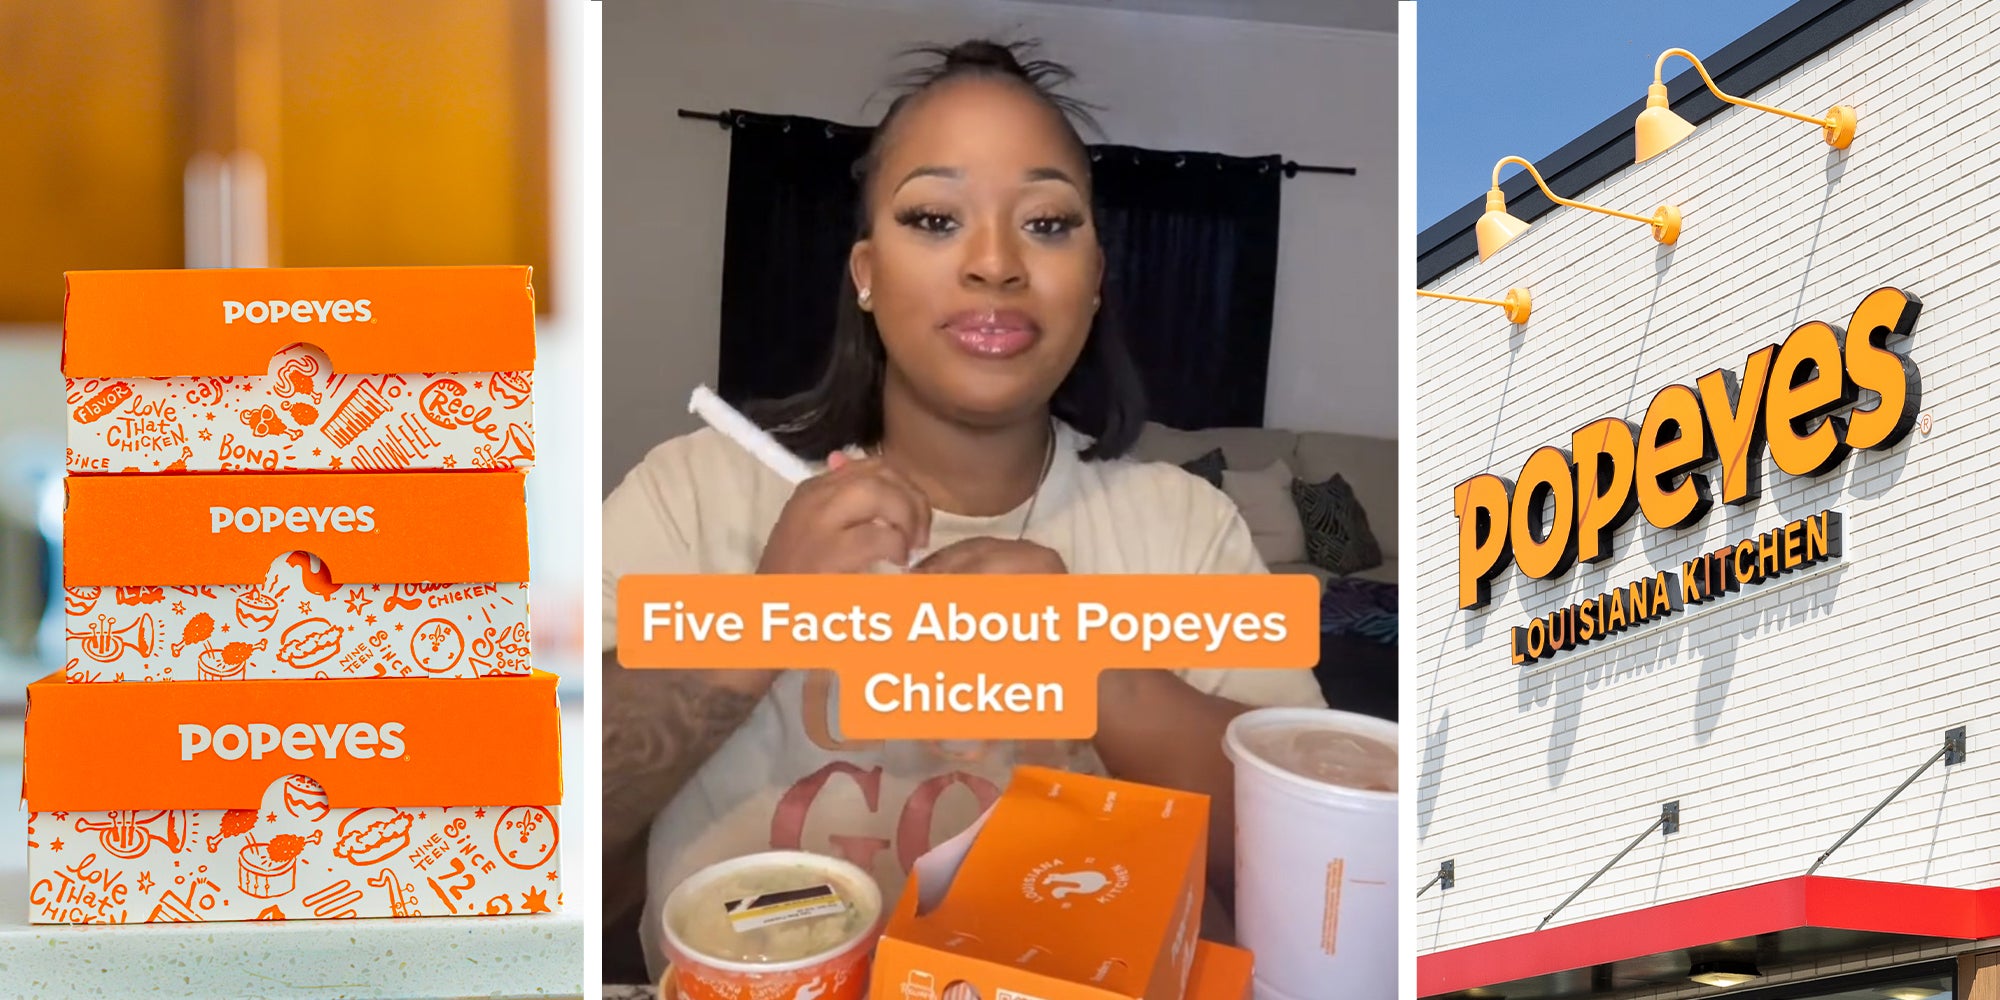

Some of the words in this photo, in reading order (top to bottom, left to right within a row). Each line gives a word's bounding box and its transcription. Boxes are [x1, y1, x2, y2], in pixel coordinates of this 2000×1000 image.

[1511, 571, 1676, 667] LOUISIANA
[1683, 510, 1838, 606] KITCHEN
[339, 642, 368, 667] NINE
[343, 649, 374, 674] TEEN
[408, 832, 442, 863] NINE
[413, 840, 451, 871] TEEN
